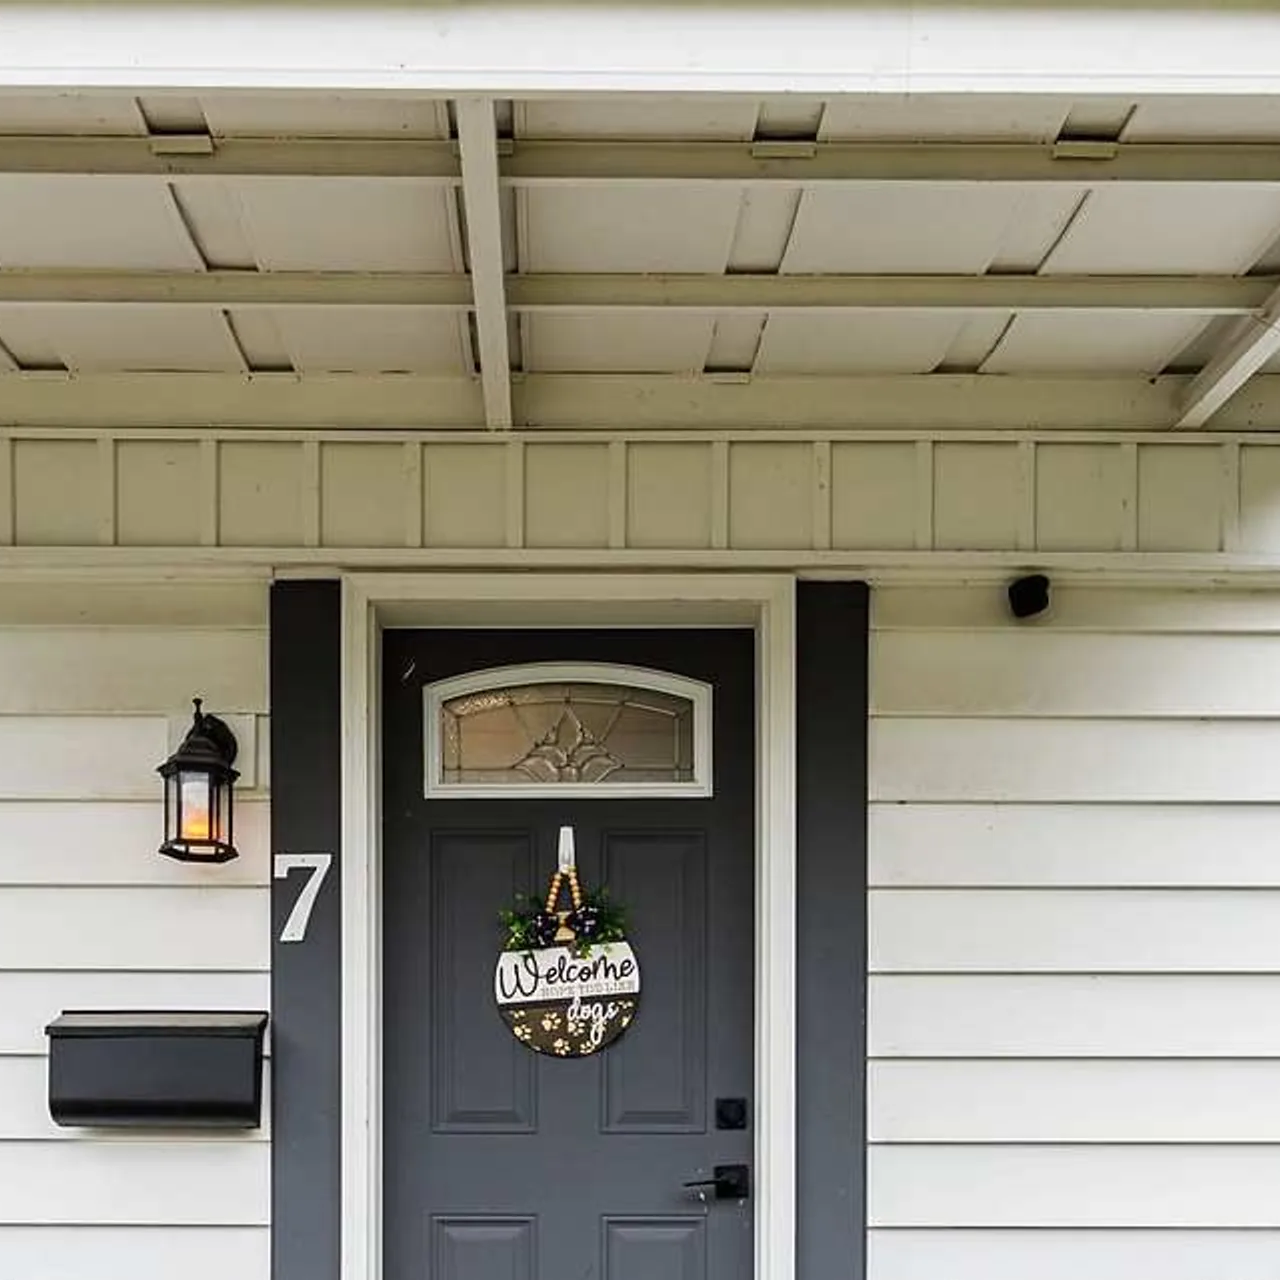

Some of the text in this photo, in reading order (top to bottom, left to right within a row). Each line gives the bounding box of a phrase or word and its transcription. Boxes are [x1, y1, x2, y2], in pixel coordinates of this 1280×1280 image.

[274, 853, 332, 942] 7
[499, 951, 636, 999] Welcome
[567, 997, 619, 1044] dogs
